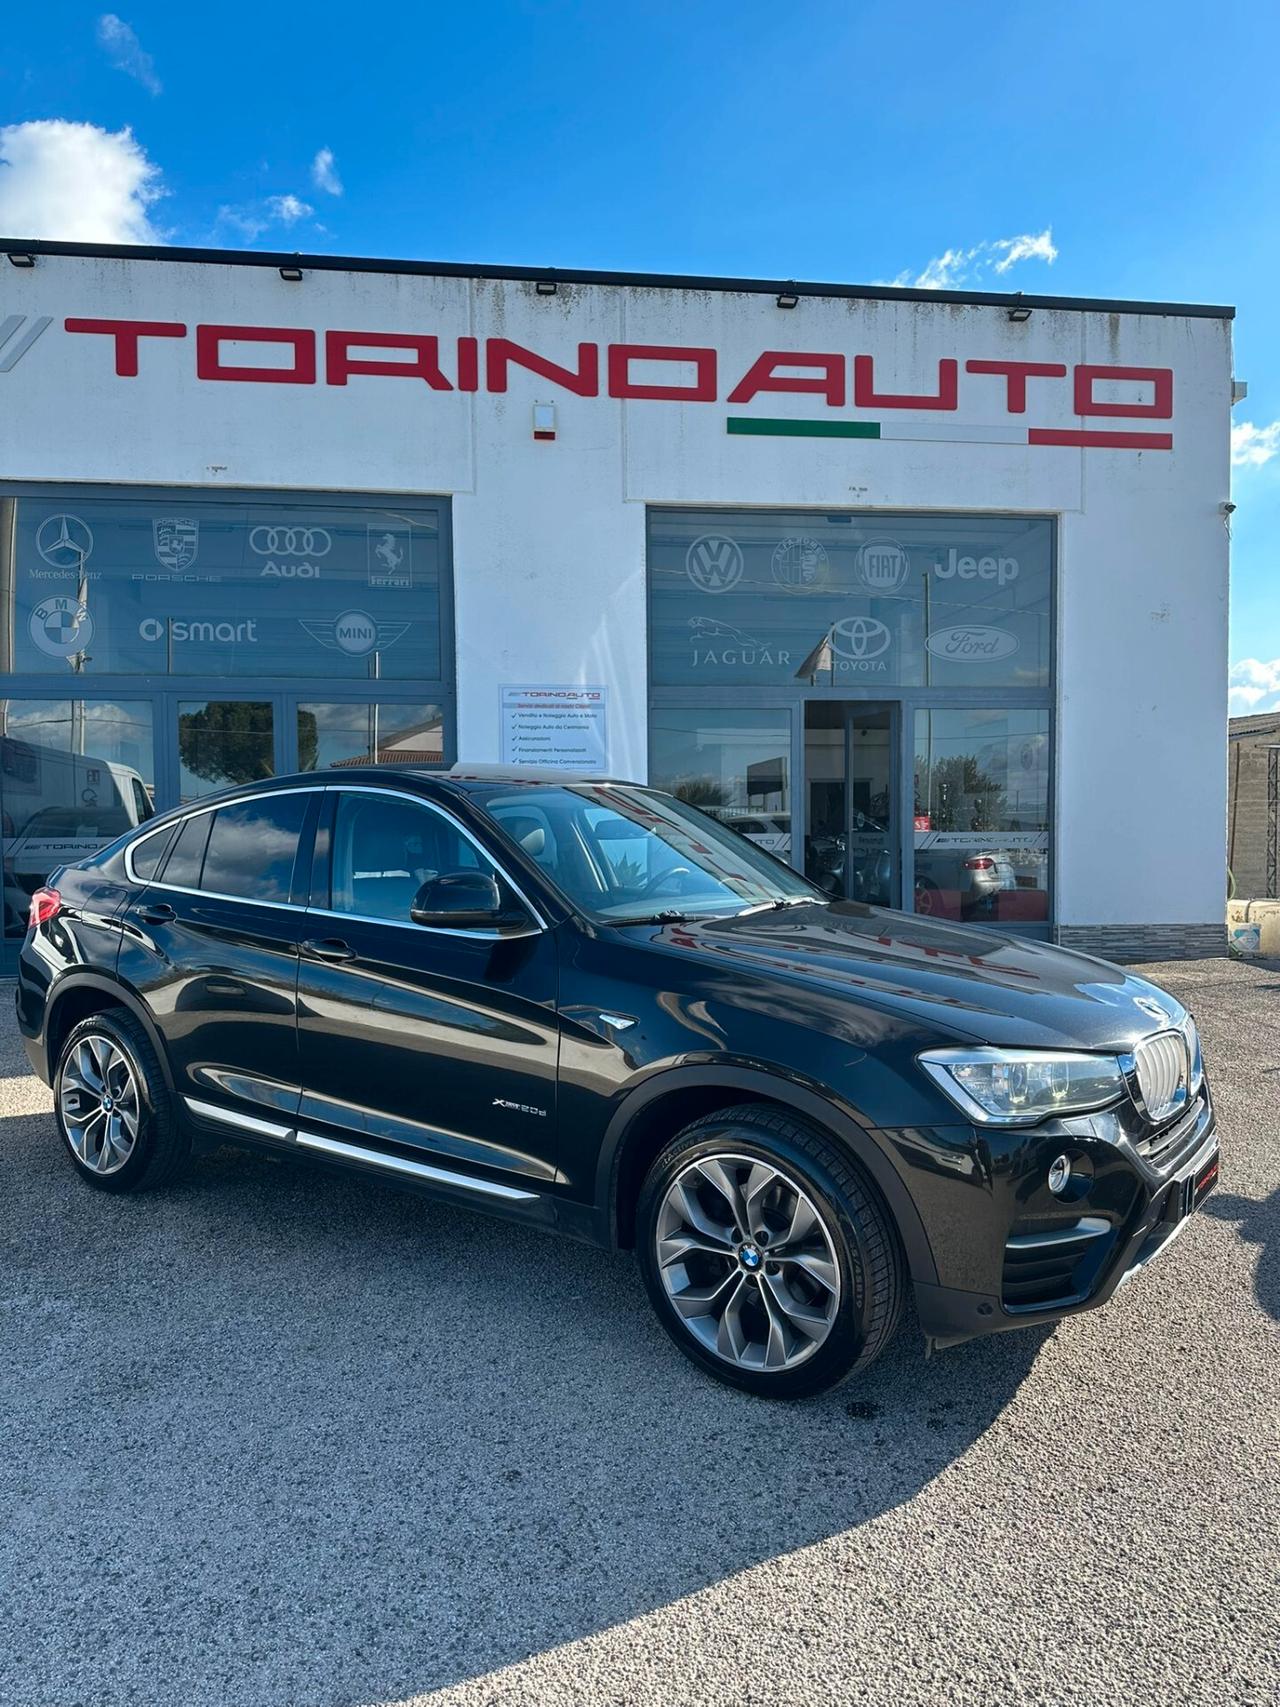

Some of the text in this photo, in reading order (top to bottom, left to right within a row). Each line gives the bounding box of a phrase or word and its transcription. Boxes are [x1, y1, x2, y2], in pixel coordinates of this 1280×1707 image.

[65, 318, 1173, 419] TORINOAUTO
[260, 560, 320, 579] Audi
[868, 554, 898, 578] FIAT
[934, 548, 1019, 585] Jeep
[131, 573, 222, 583] PORSCHE
[370, 575, 409, 587] Ferrari
[171, 619, 258, 643] smart
[339, 626, 372, 641] MINI
[945, 630, 1000, 655] Ford
[692, 649, 791, 668] JAGUAR
[832, 660, 888, 672] TOYOTA
